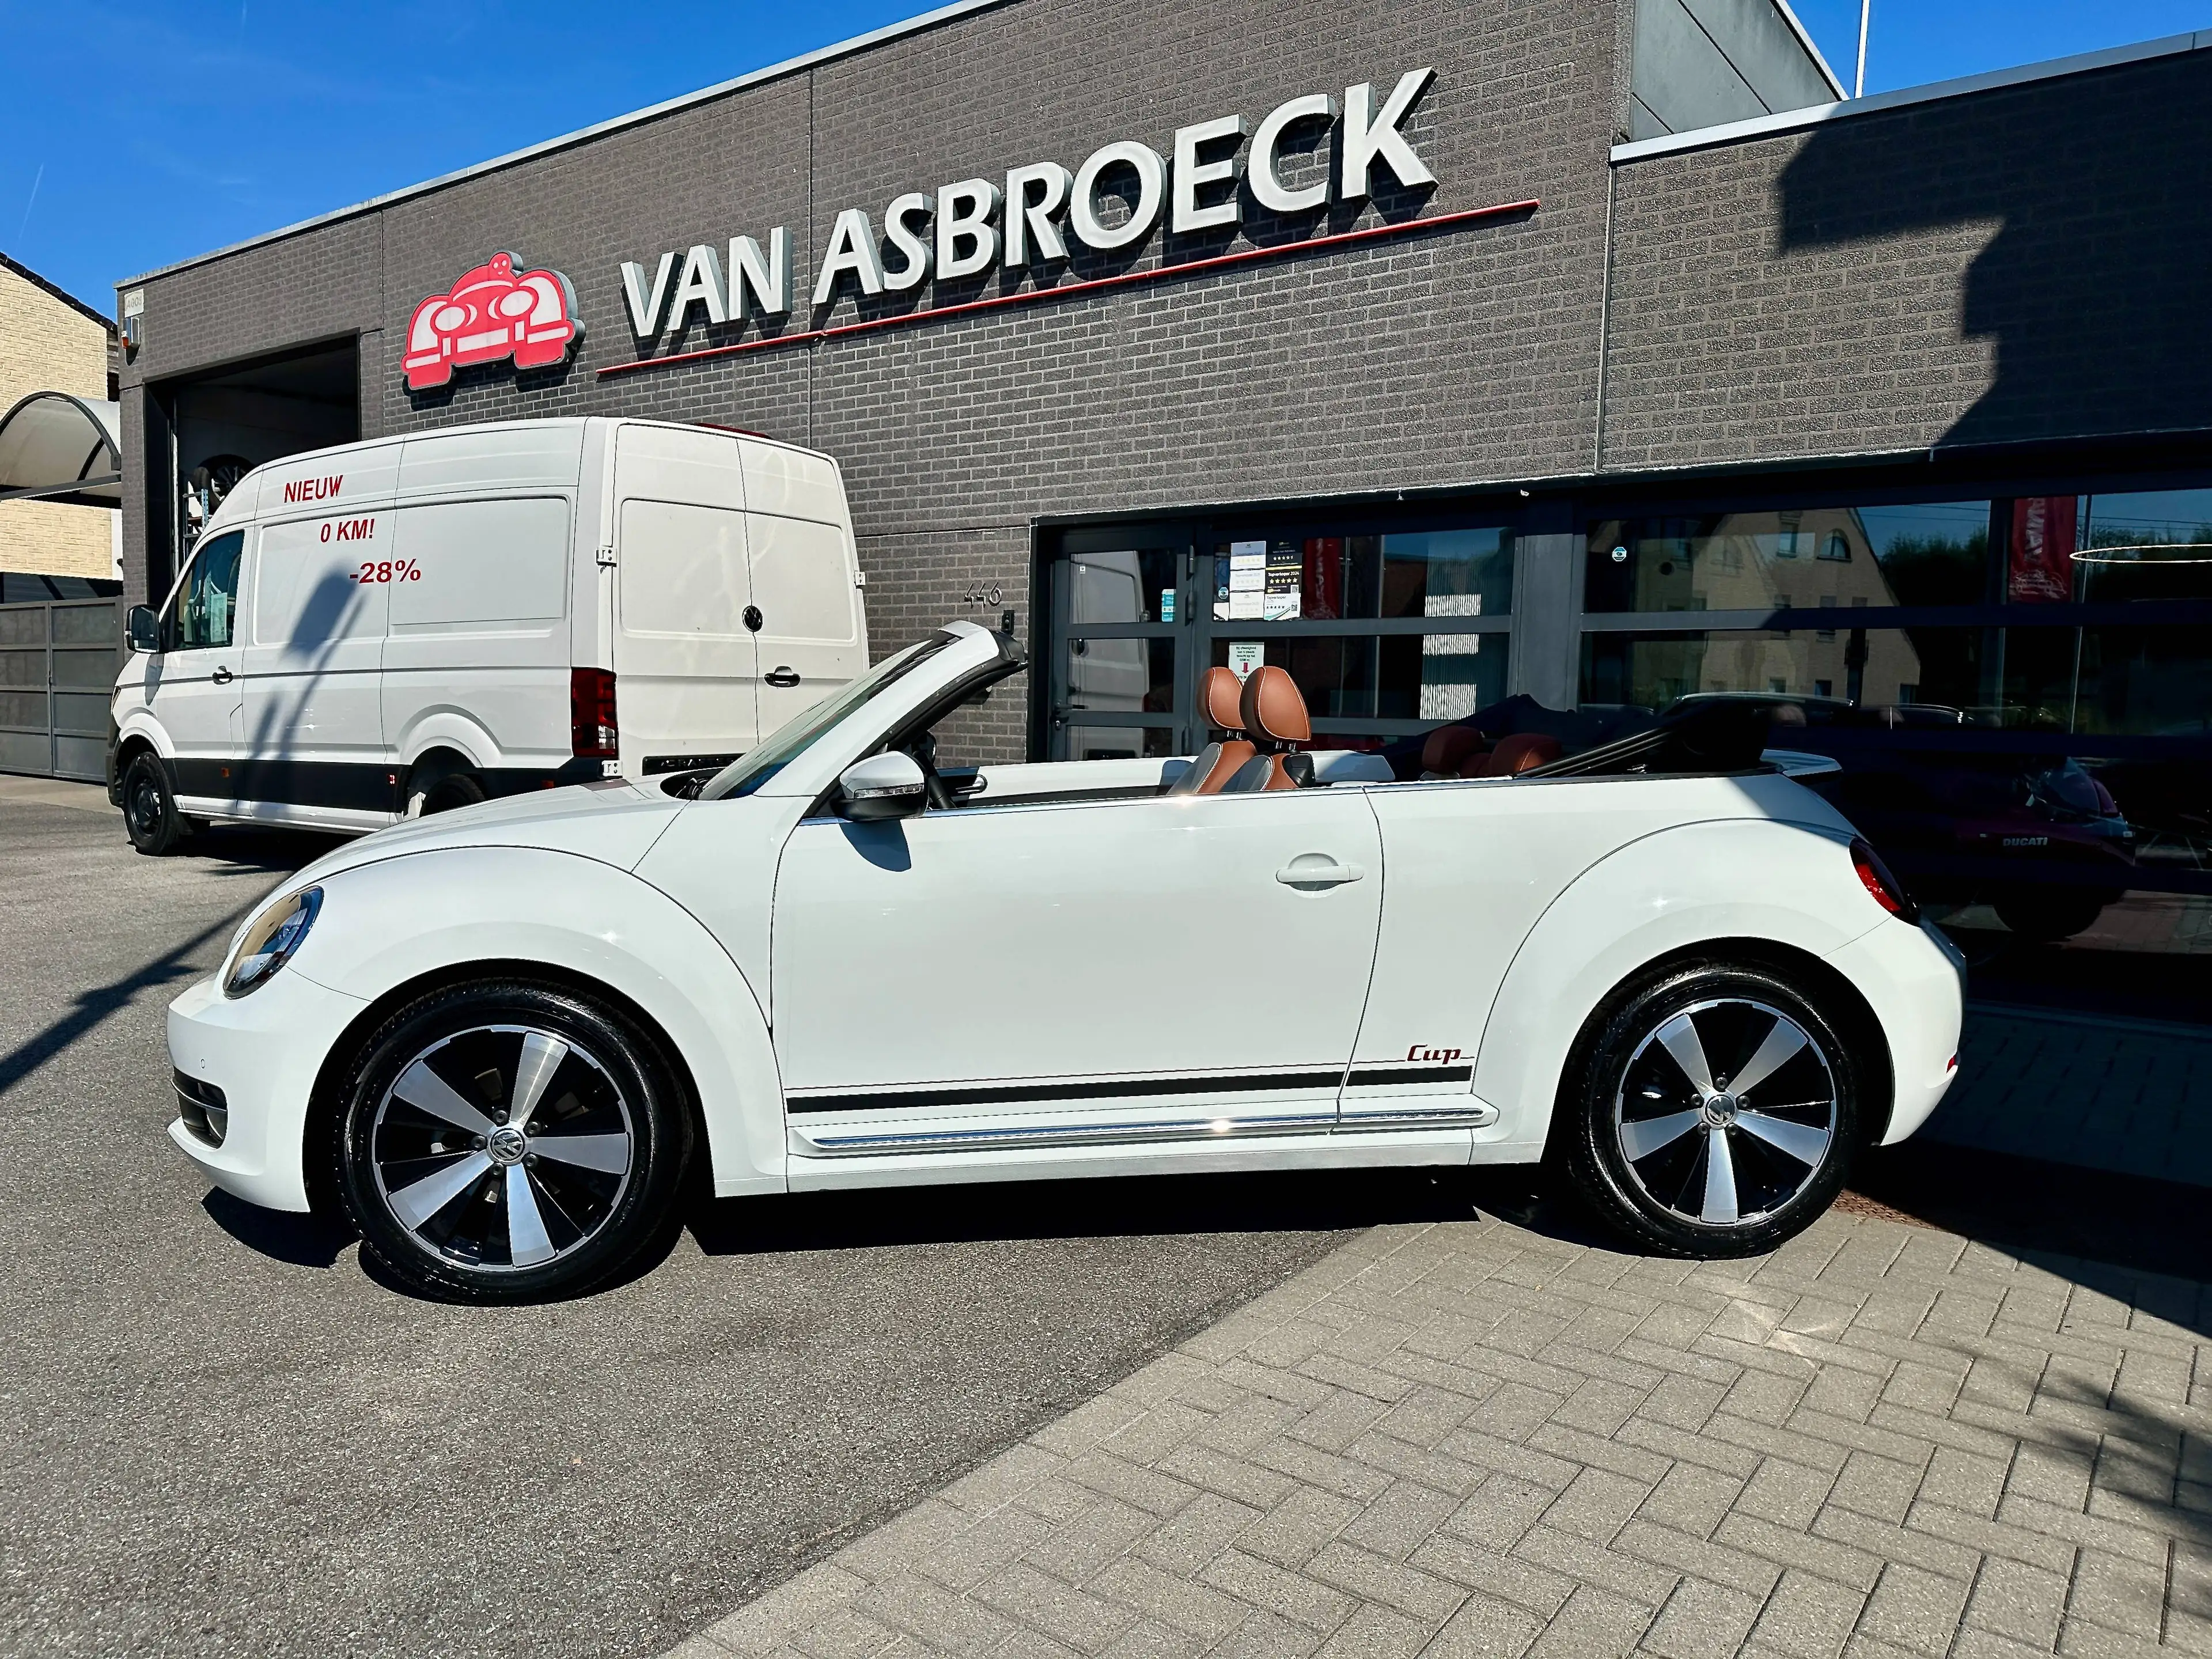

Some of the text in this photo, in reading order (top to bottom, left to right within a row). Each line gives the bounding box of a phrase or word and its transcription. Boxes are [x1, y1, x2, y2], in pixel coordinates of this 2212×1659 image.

[620, 66, 1438, 338] VAN ASBROECK
[284, 475, 343, 503] NIEUW
[320, 518, 375, 543] 0 KM!
[349, 558, 422, 584] -28%
[963, 581, 1002, 609] 446
[2002, 836, 2048, 847] DUCATI
[1407, 1044, 1461, 1065] Cup
